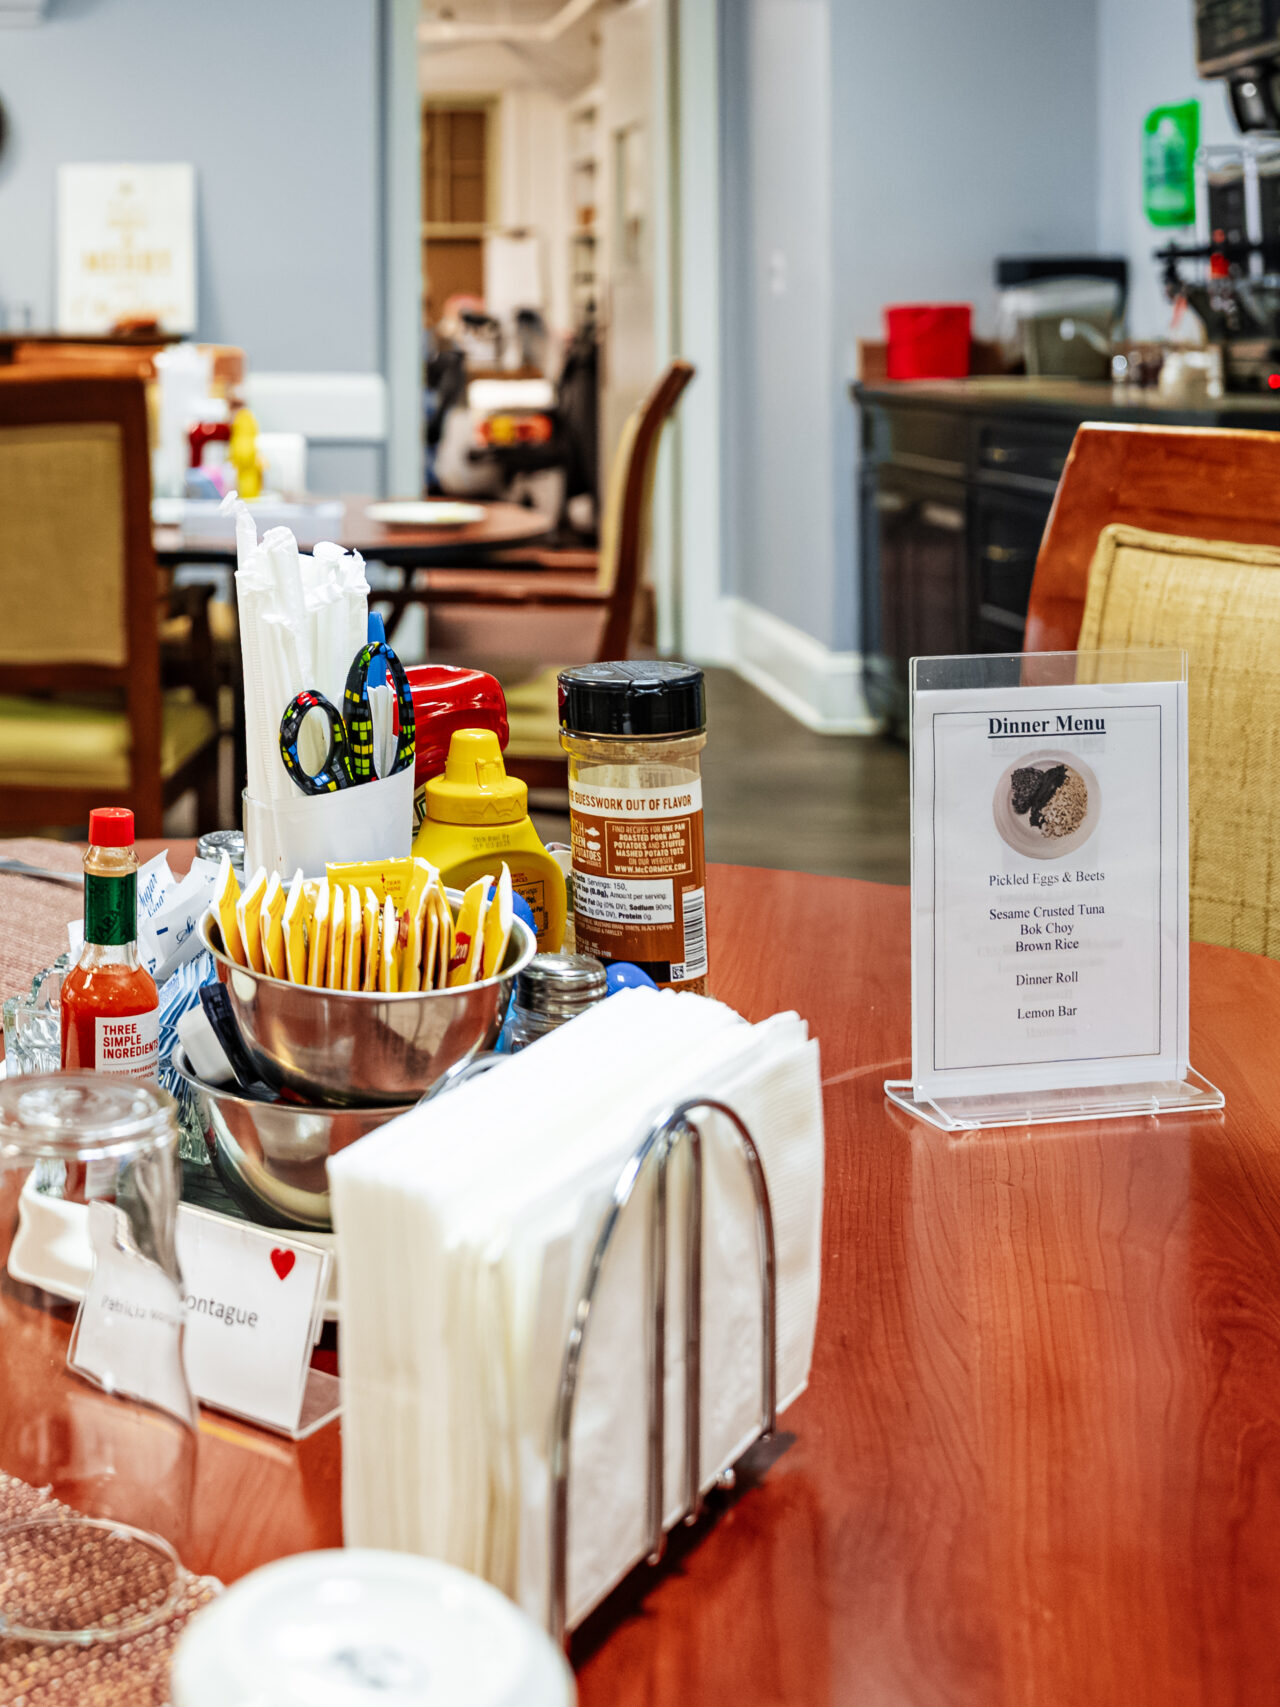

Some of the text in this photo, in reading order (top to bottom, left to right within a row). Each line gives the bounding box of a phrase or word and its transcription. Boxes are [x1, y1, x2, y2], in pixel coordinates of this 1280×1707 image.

[988, 715, 1106, 735] Dinner Menu
[575, 791, 623, 811] GUESSWORK
[626, 799, 645, 811] OUT
[649, 798, 661, 810] OF
[663, 794, 692, 809] FLAVOR
[626, 826, 649, 834] RECIPES
[662, 825, 674, 833] ONE
[674, 823, 686, 831] PAN
[619, 832, 681, 841] ROASTED PORK AND
[614, 839, 685, 849] POTATOES AND STUFFED
[616, 847, 684, 857] MASHED POTATO TOTS
[989, 870, 1105, 886] Pickled Eggs & Beets
[610, 891, 632, 900] Amount
[633, 893, 643, 901] per
[618, 912, 642, 920] Protein
[989, 903, 1105, 920] Sesame Crusted Tuna
[1020, 922, 1074, 935] Bok Choy
[1015, 938, 1079, 952] Brown Rice
[1016, 971, 1078, 986] Dinner Roll
[1017, 1005, 1078, 1019] Lemon Bar
[103, 1023, 137, 1035] THREE
[103, 1034, 141, 1047] SIMPLE
[103, 1038, 158, 1059] INGREDIENTS
